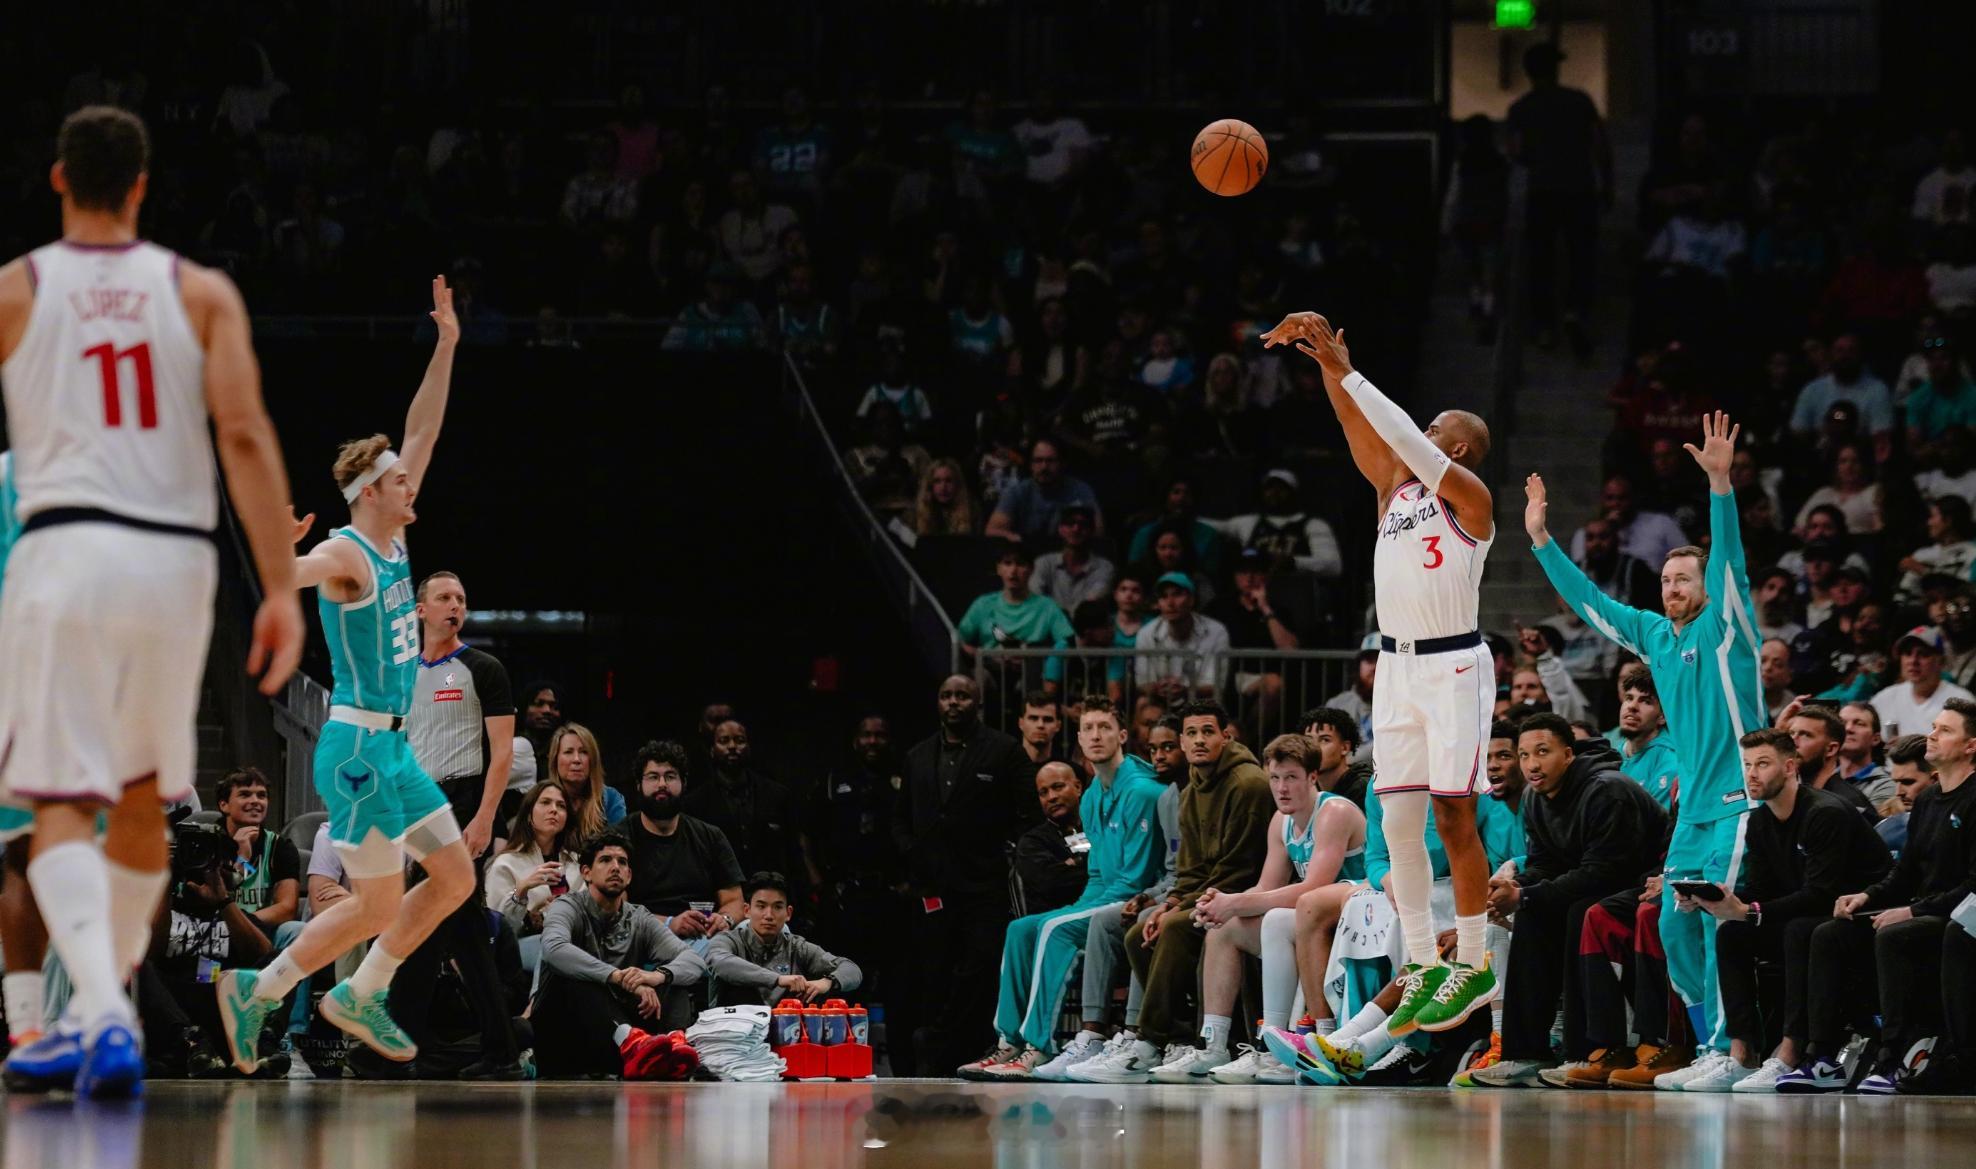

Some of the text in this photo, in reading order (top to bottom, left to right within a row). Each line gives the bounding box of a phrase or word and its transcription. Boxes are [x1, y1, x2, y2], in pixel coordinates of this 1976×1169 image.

[82, 342, 157, 429] 11
[1422, 536, 1443, 569] 3
[391, 610, 420, 665] 33
[434, 692, 463, 700] Emirates
